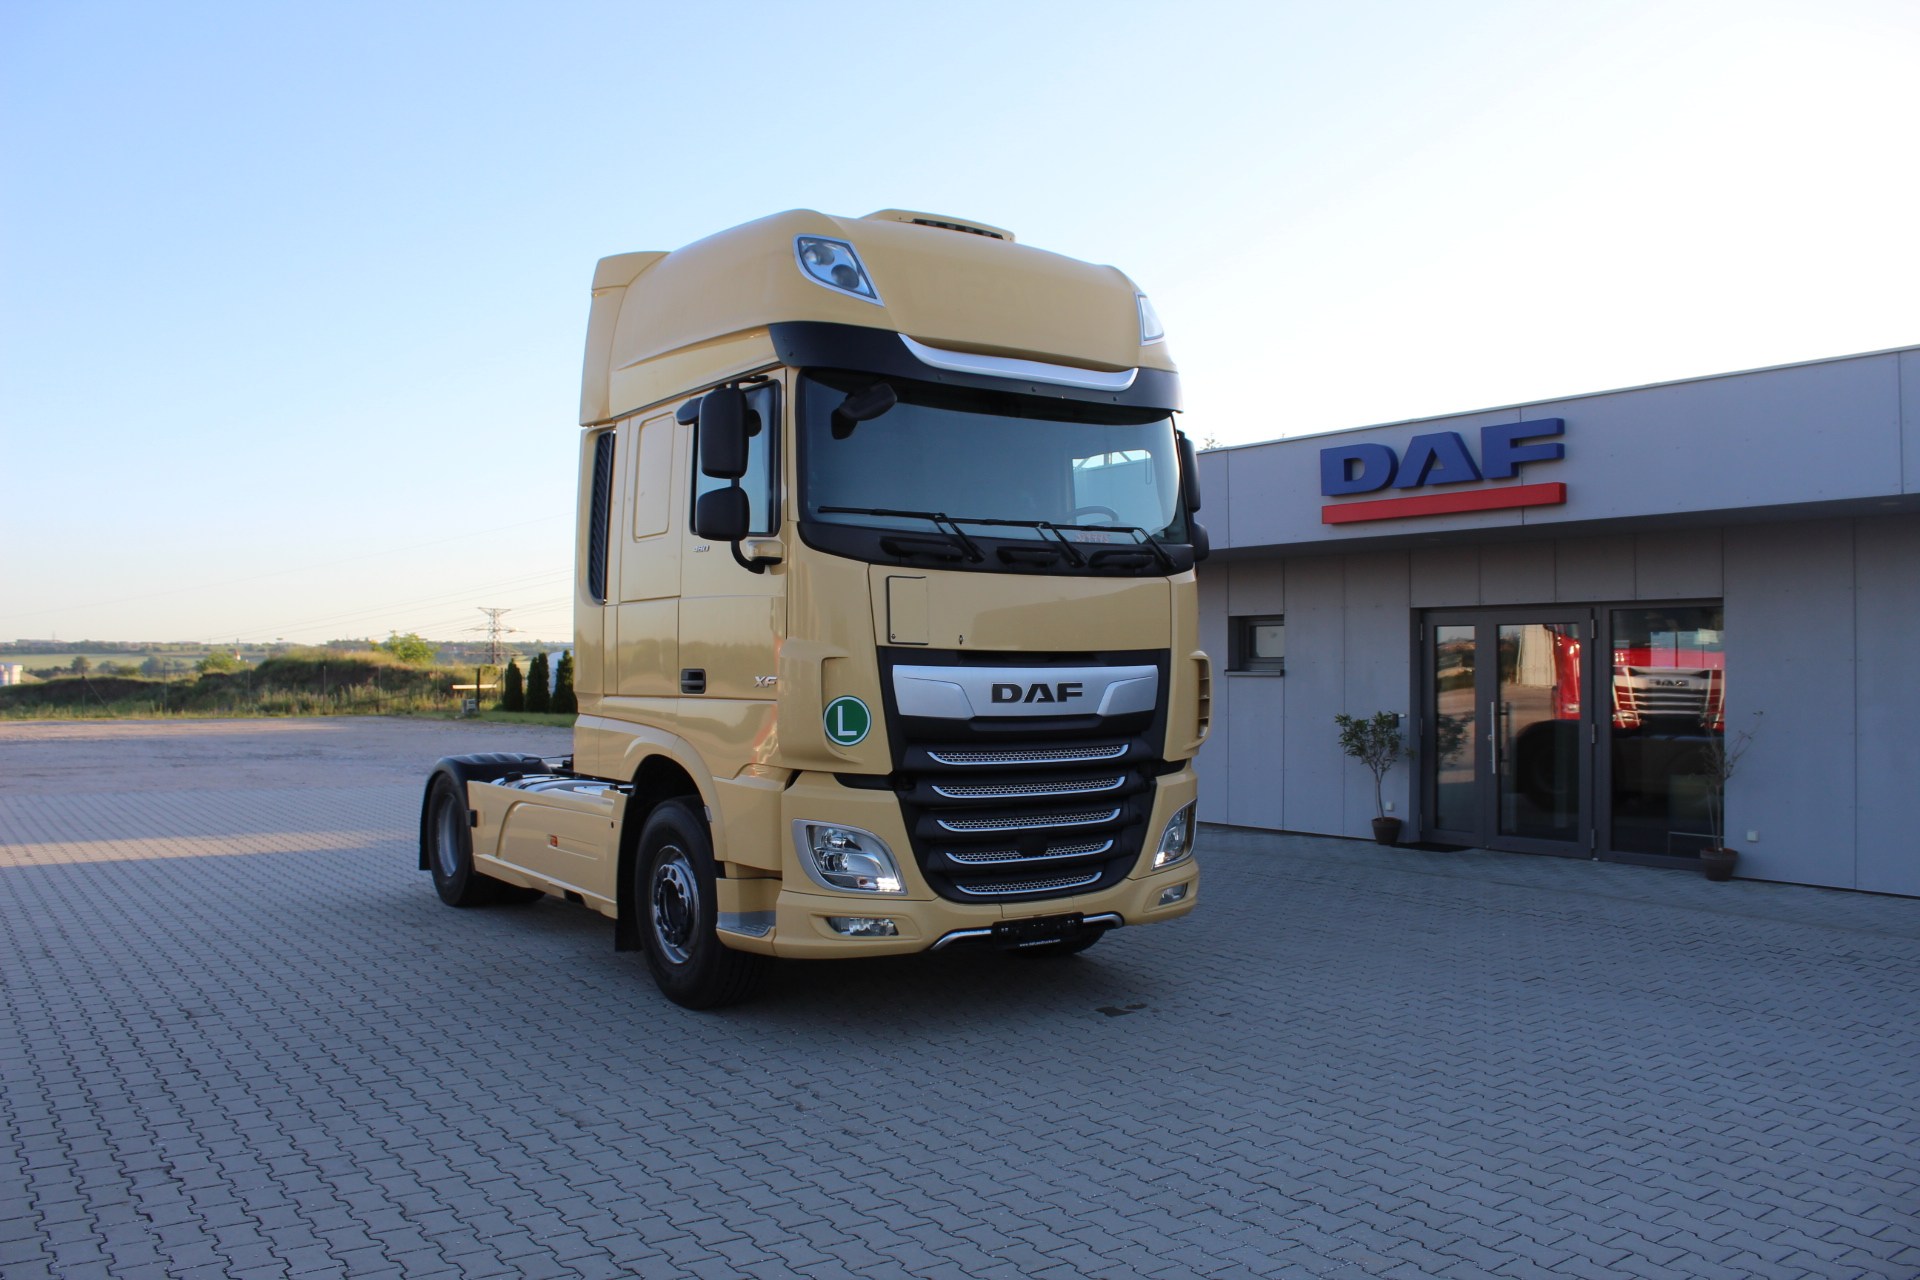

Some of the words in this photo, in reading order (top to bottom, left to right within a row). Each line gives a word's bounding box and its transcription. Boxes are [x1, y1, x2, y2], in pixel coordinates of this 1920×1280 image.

[1320, 417, 1565, 497] DAF
[754, 676, 778, 688] XF
[991, 682, 1083, 703] DAF
[837, 705, 857, 736] L
